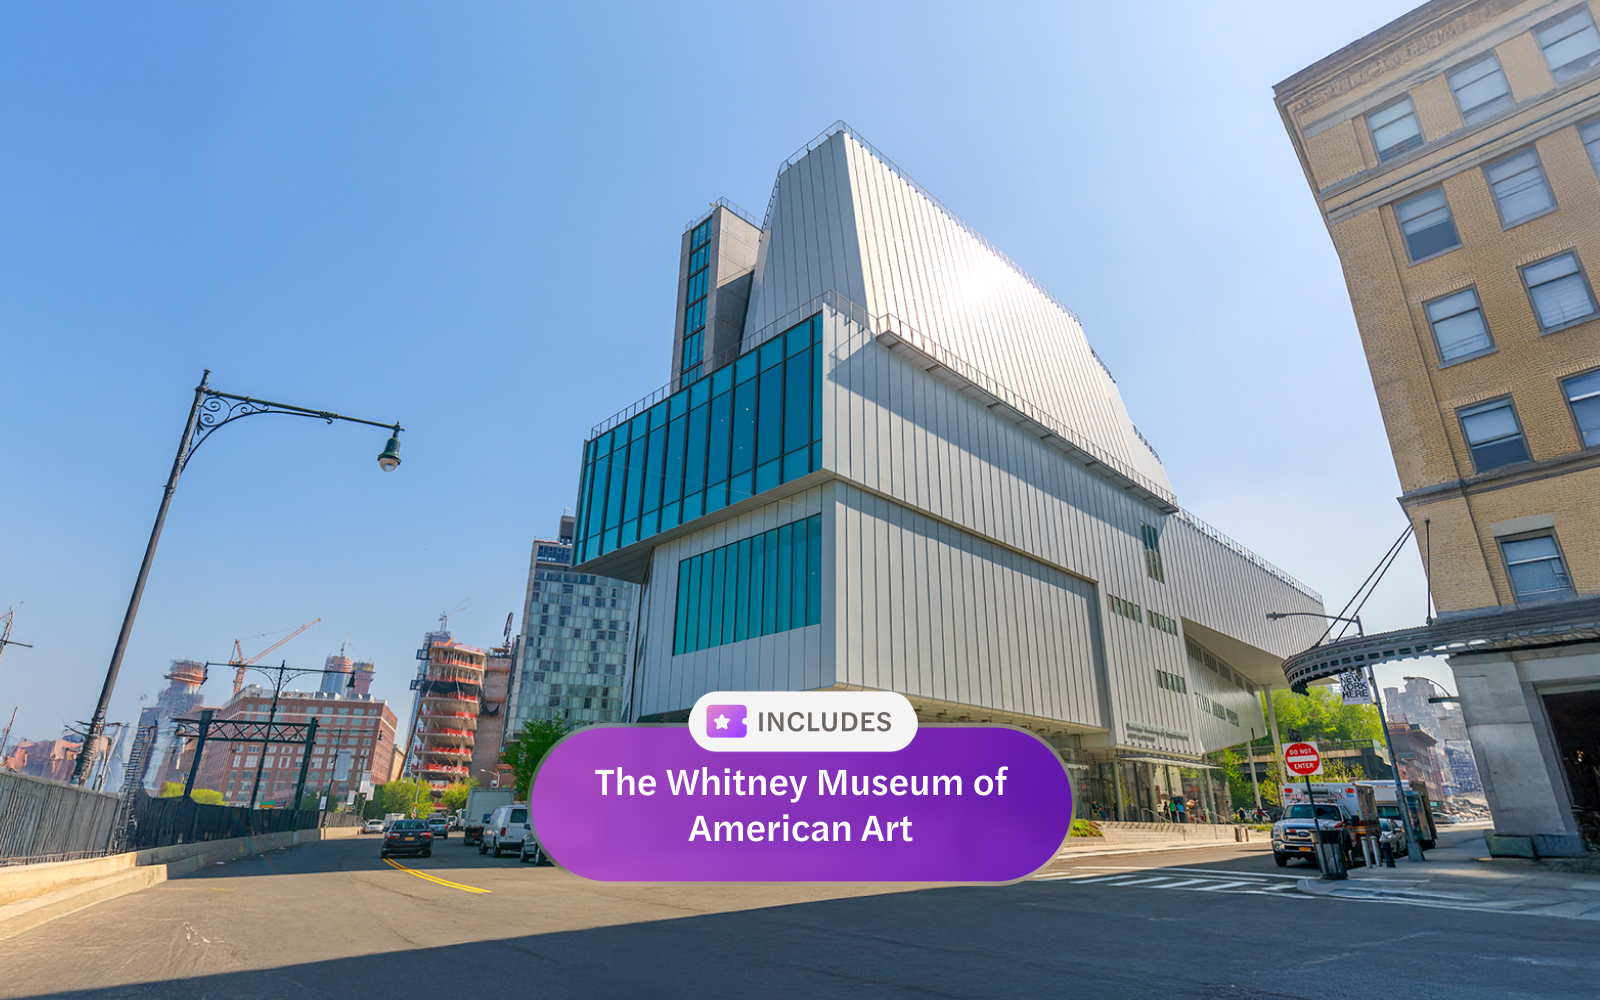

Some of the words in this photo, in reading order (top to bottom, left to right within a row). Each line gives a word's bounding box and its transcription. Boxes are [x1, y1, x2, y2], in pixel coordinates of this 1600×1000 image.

[1341, 681, 1368, 691] YORK
[1342, 689, 1369, 699] HERE
[1294, 762, 1315, 770] ENTER
